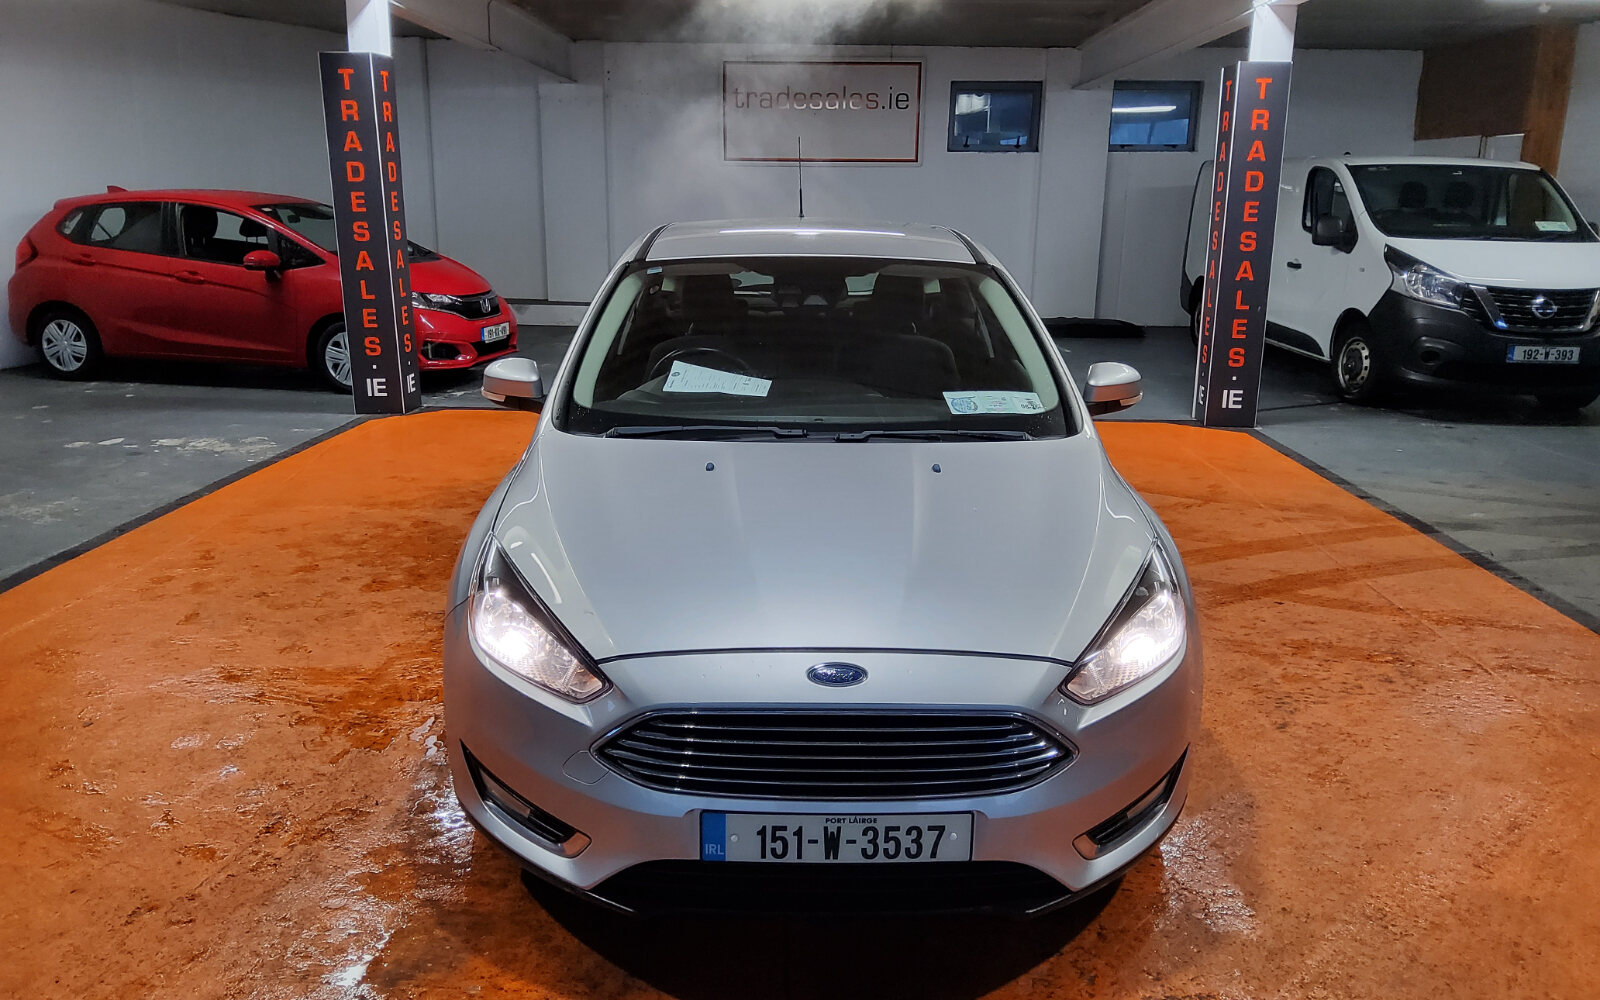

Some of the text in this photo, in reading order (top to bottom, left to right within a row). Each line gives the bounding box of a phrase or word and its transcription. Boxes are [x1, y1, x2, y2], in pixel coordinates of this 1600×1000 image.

[733, 85, 910, 110] tradesales.ie
[1522, 349, 1574, 361] 192-W-393
[705, 843, 725, 855] IRL
[756, 825, 946, 860] 151-W-3537
